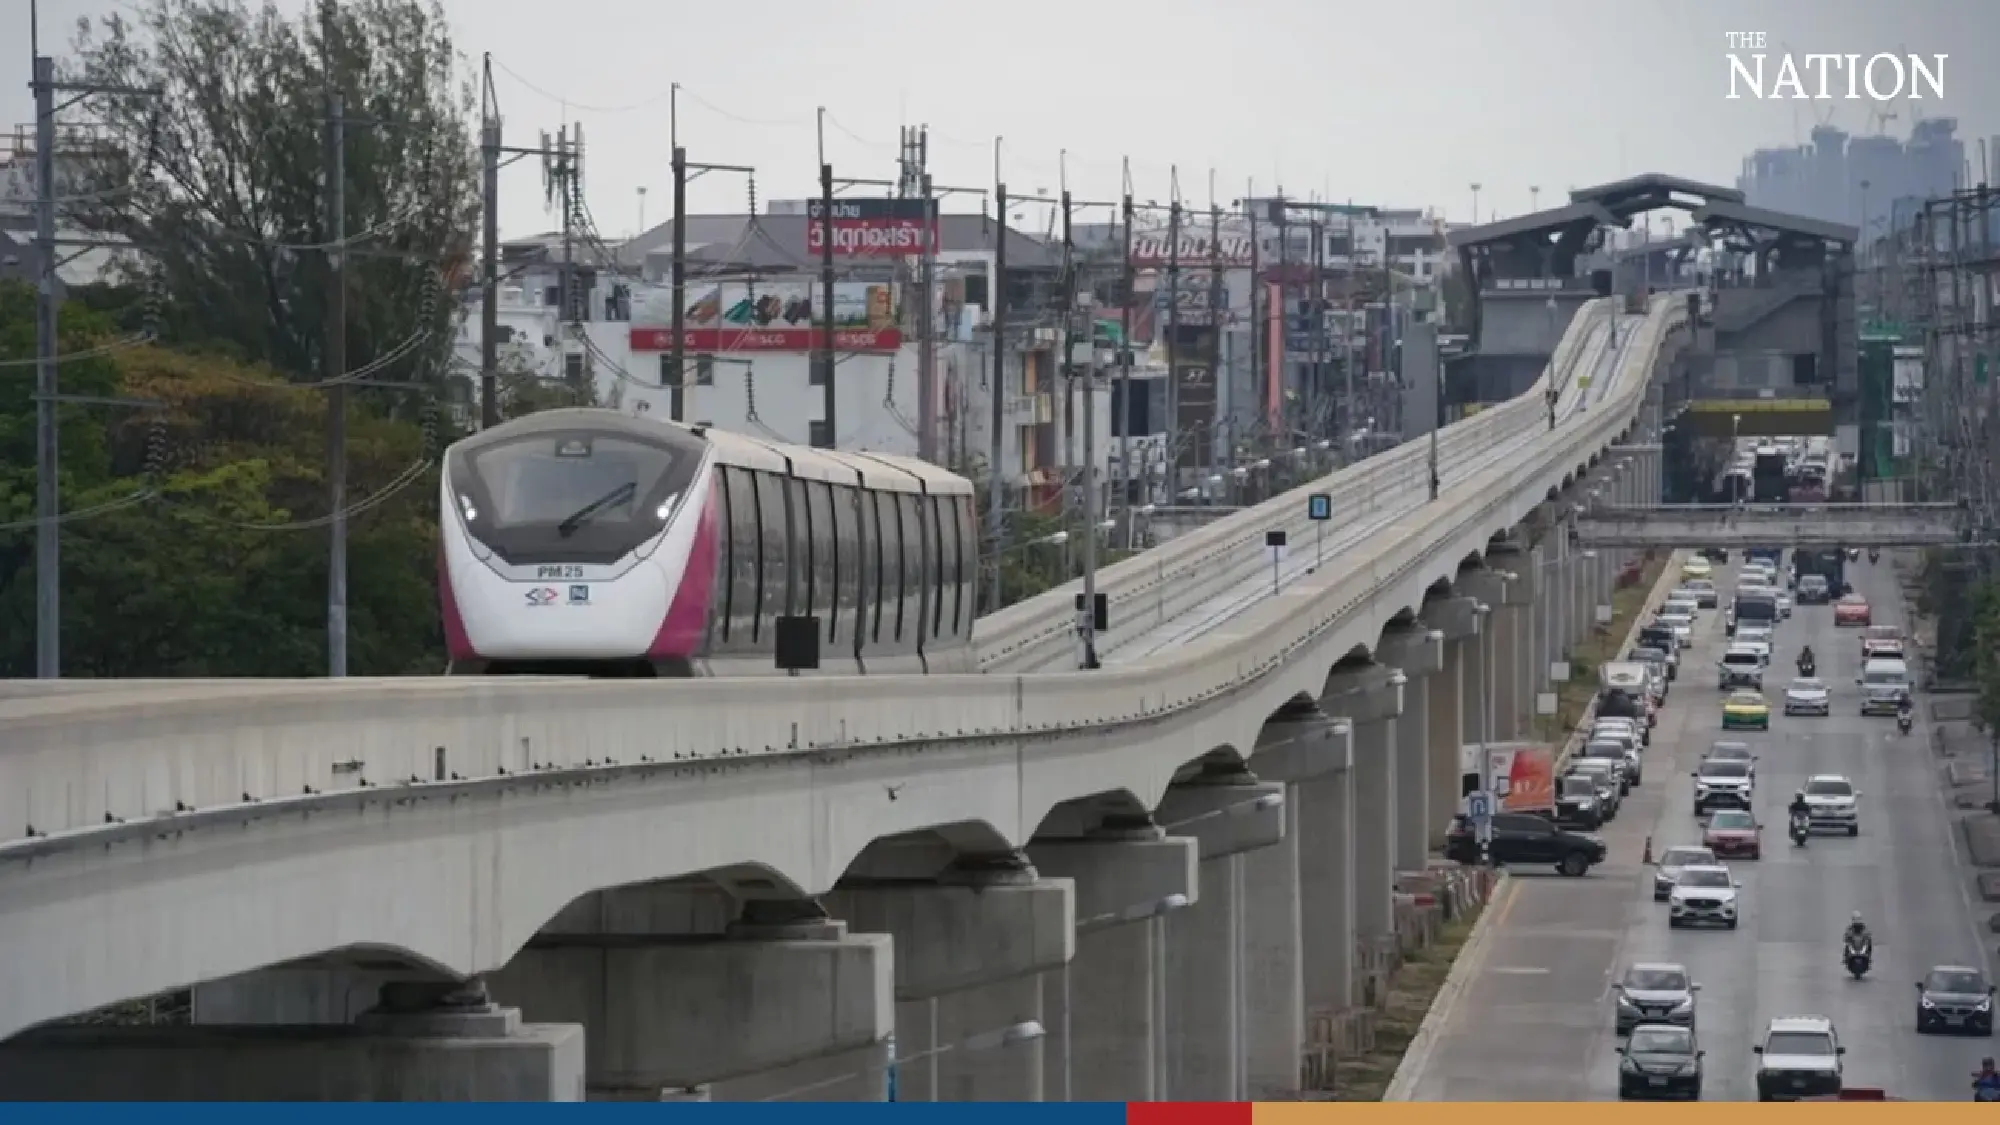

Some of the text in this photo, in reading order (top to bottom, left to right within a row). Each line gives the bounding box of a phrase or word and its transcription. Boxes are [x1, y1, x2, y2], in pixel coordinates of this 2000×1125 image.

[810, 220, 935, 252] วัดุก่อสร้า
[1131, 238, 1252, 259] FOODLND
